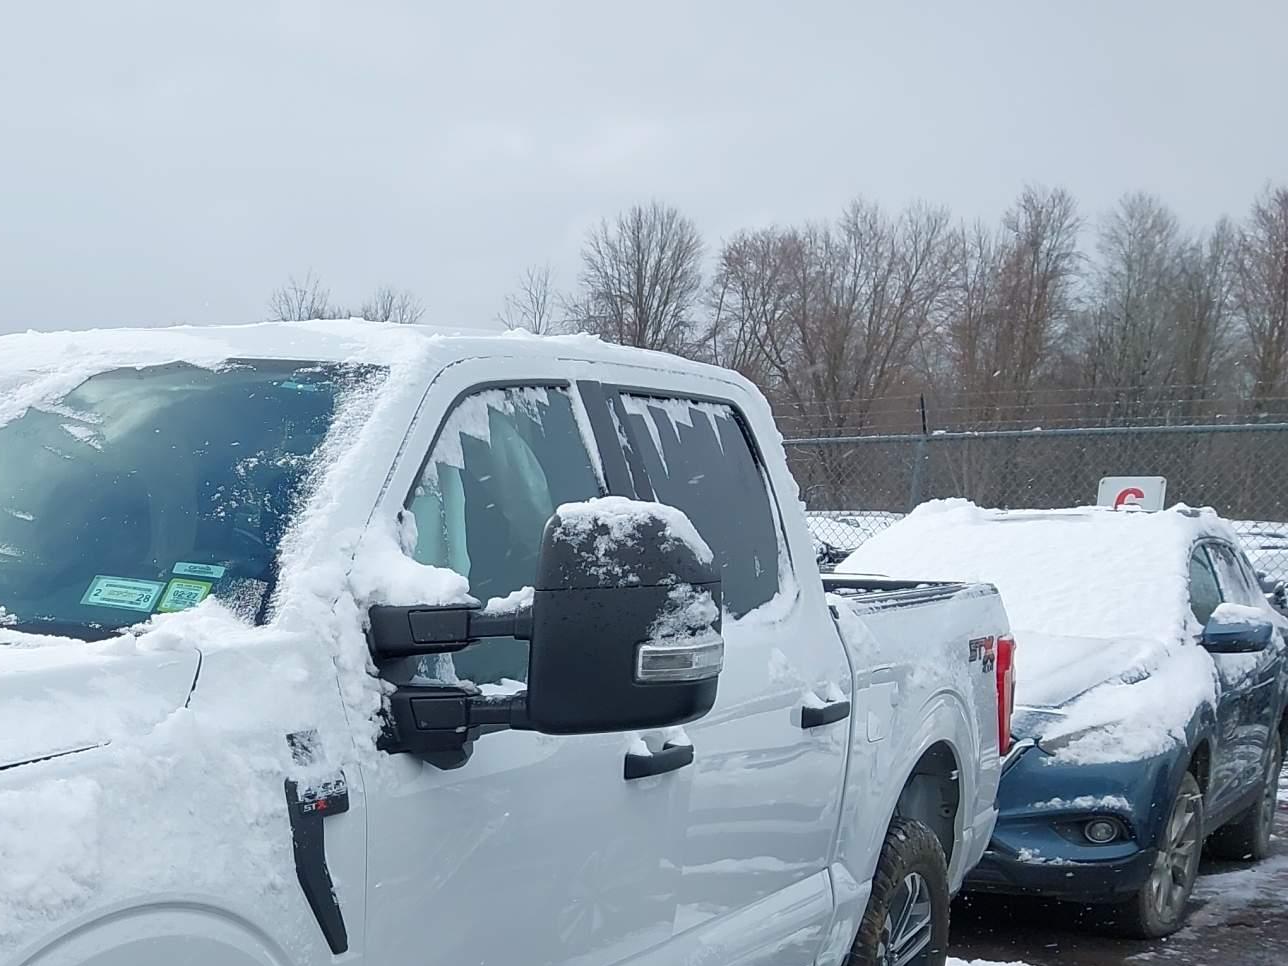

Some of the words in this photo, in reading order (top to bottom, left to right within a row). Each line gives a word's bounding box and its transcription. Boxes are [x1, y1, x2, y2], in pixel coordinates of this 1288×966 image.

[93, 588, 102, 597] 2
[135, 593, 152, 603] 28
[303, 799, 328, 813] STX
